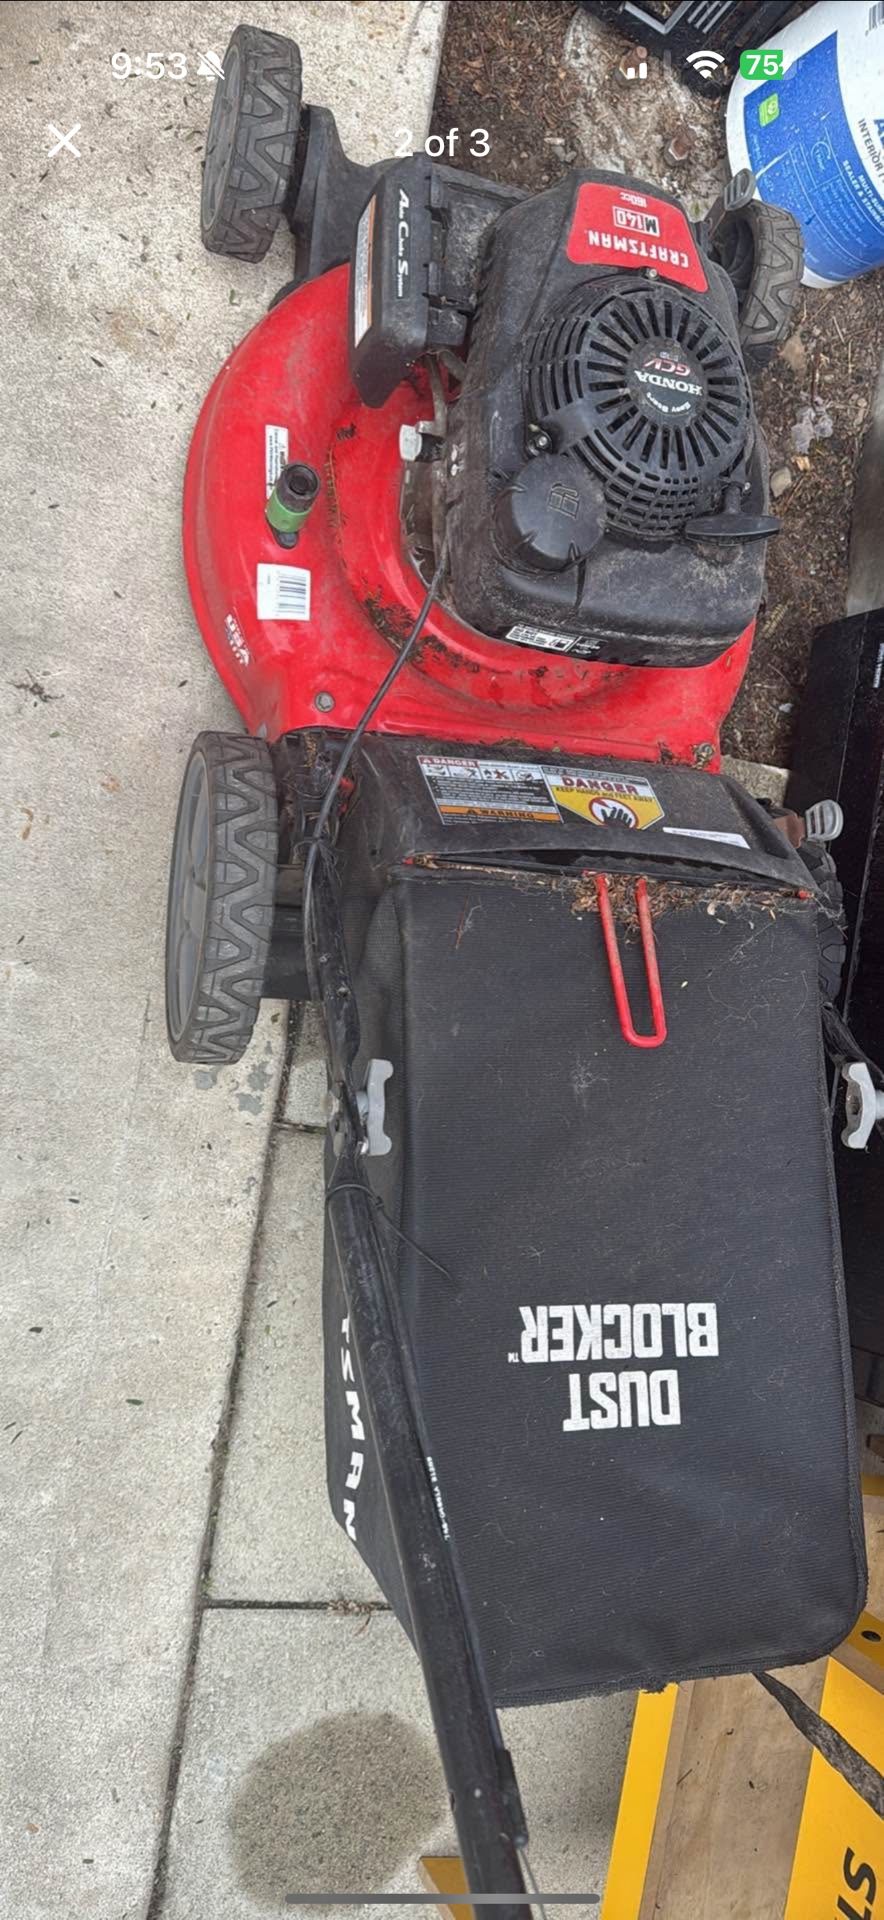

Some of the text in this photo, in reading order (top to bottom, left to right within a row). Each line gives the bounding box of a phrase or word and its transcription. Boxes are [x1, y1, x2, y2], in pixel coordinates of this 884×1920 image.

[858, 118, 883, 172] INTERIOR
[843, 160, 860, 189] SEALER
[616, 208, 657, 234] M140
[588, 230, 689, 268] CRAFTSMAN
[397, 259, 409, 297] System
[634, 370, 703, 396] HONDA
[643, 357, 691, 377] GCV
[433, 758, 477, 767] DANGER
[562, 776, 639, 794] DANGER
[521, 1303, 719, 1363] BLOCKER
[563, 1370, 681, 1432] DUST
[834, 1847, 877, 1920] ST
